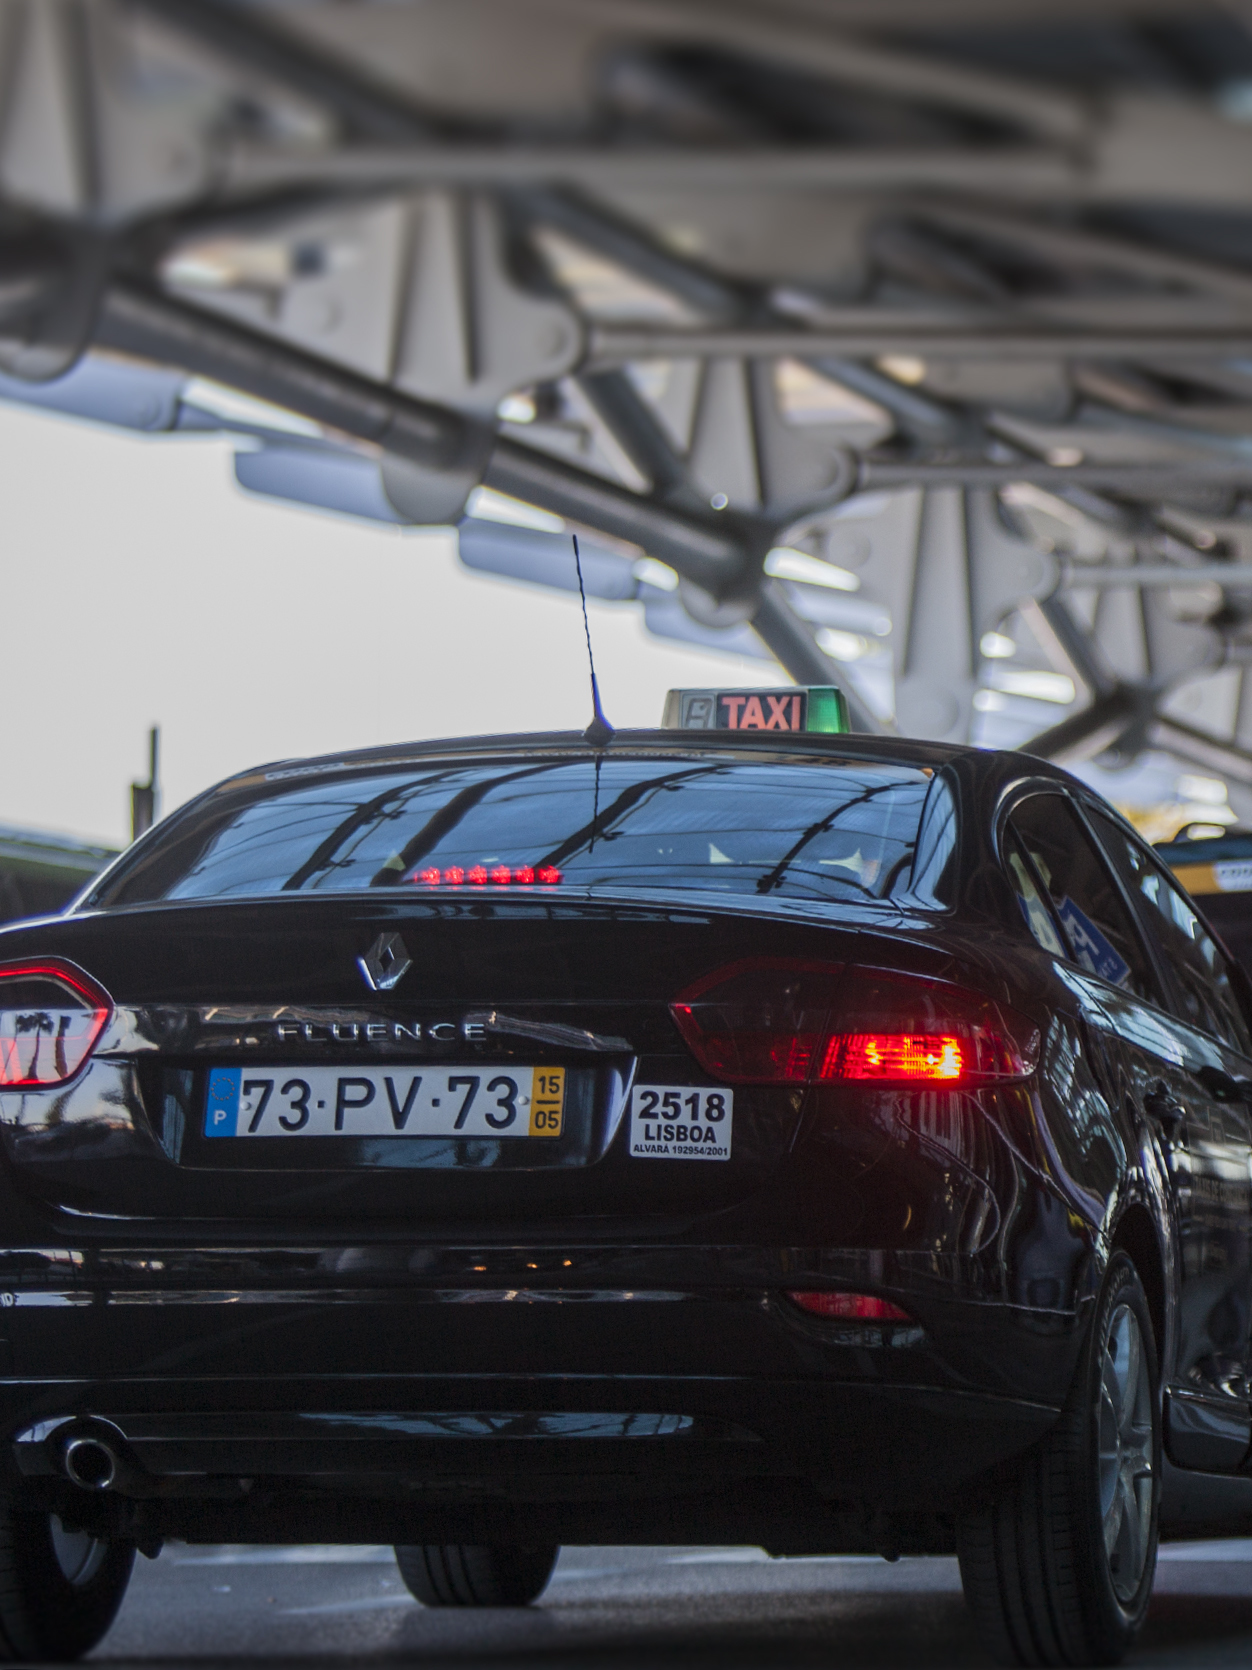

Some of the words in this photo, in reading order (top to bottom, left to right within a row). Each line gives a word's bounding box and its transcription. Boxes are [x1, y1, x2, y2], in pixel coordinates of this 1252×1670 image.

[722, 695, 802, 731] TAXI
[277, 1022, 488, 1042] FLUENCE
[537, 1075, 561, 1094] 15
[638, 1090, 726, 1122] 2518
[213, 1109, 227, 1125] P
[534, 1111, 560, 1130] 05
[644, 1123, 717, 1144] LISBOA
